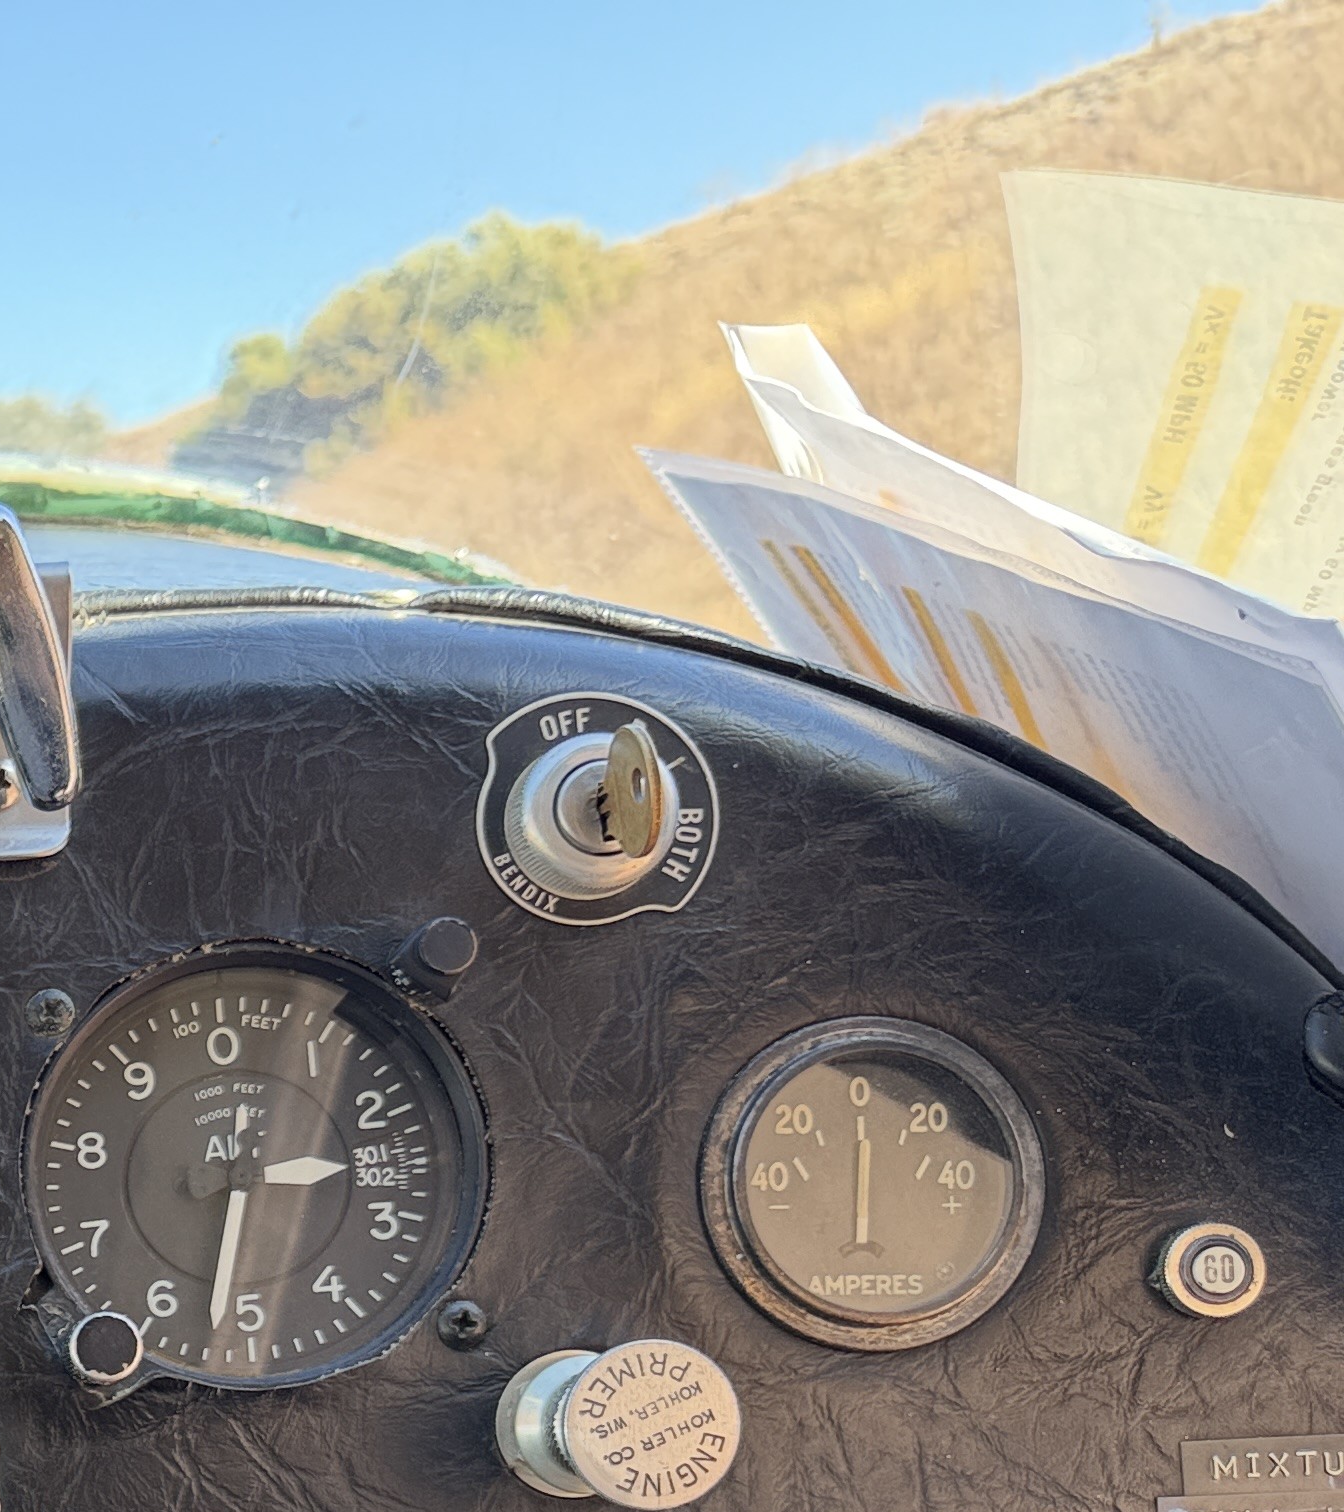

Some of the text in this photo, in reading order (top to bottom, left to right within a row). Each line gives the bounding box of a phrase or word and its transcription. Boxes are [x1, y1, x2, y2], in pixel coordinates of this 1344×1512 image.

[538, 707, 591, 741] OFF
[661, 808, 704, 883] BOTH
[493, 852, 560, 913] BENDIX
[172, 1014, 282, 1039] 100 FEET
[774, 1103, 813, 1135] 20
[910, 1102, 949, 1133] 20
[751, 1162, 789, 1192] 40
[937, 1159, 975, 1190] 40
[808, 1274, 923, 1297] AMPERES
[578, 1352, 692, 1420] PRIMER
[590, 1381, 703, 1439] KOHLER, WIS.
[603, 1408, 716, 1466] KOHLER CO.
[615, 1432, 726, 1497] ENGINE
